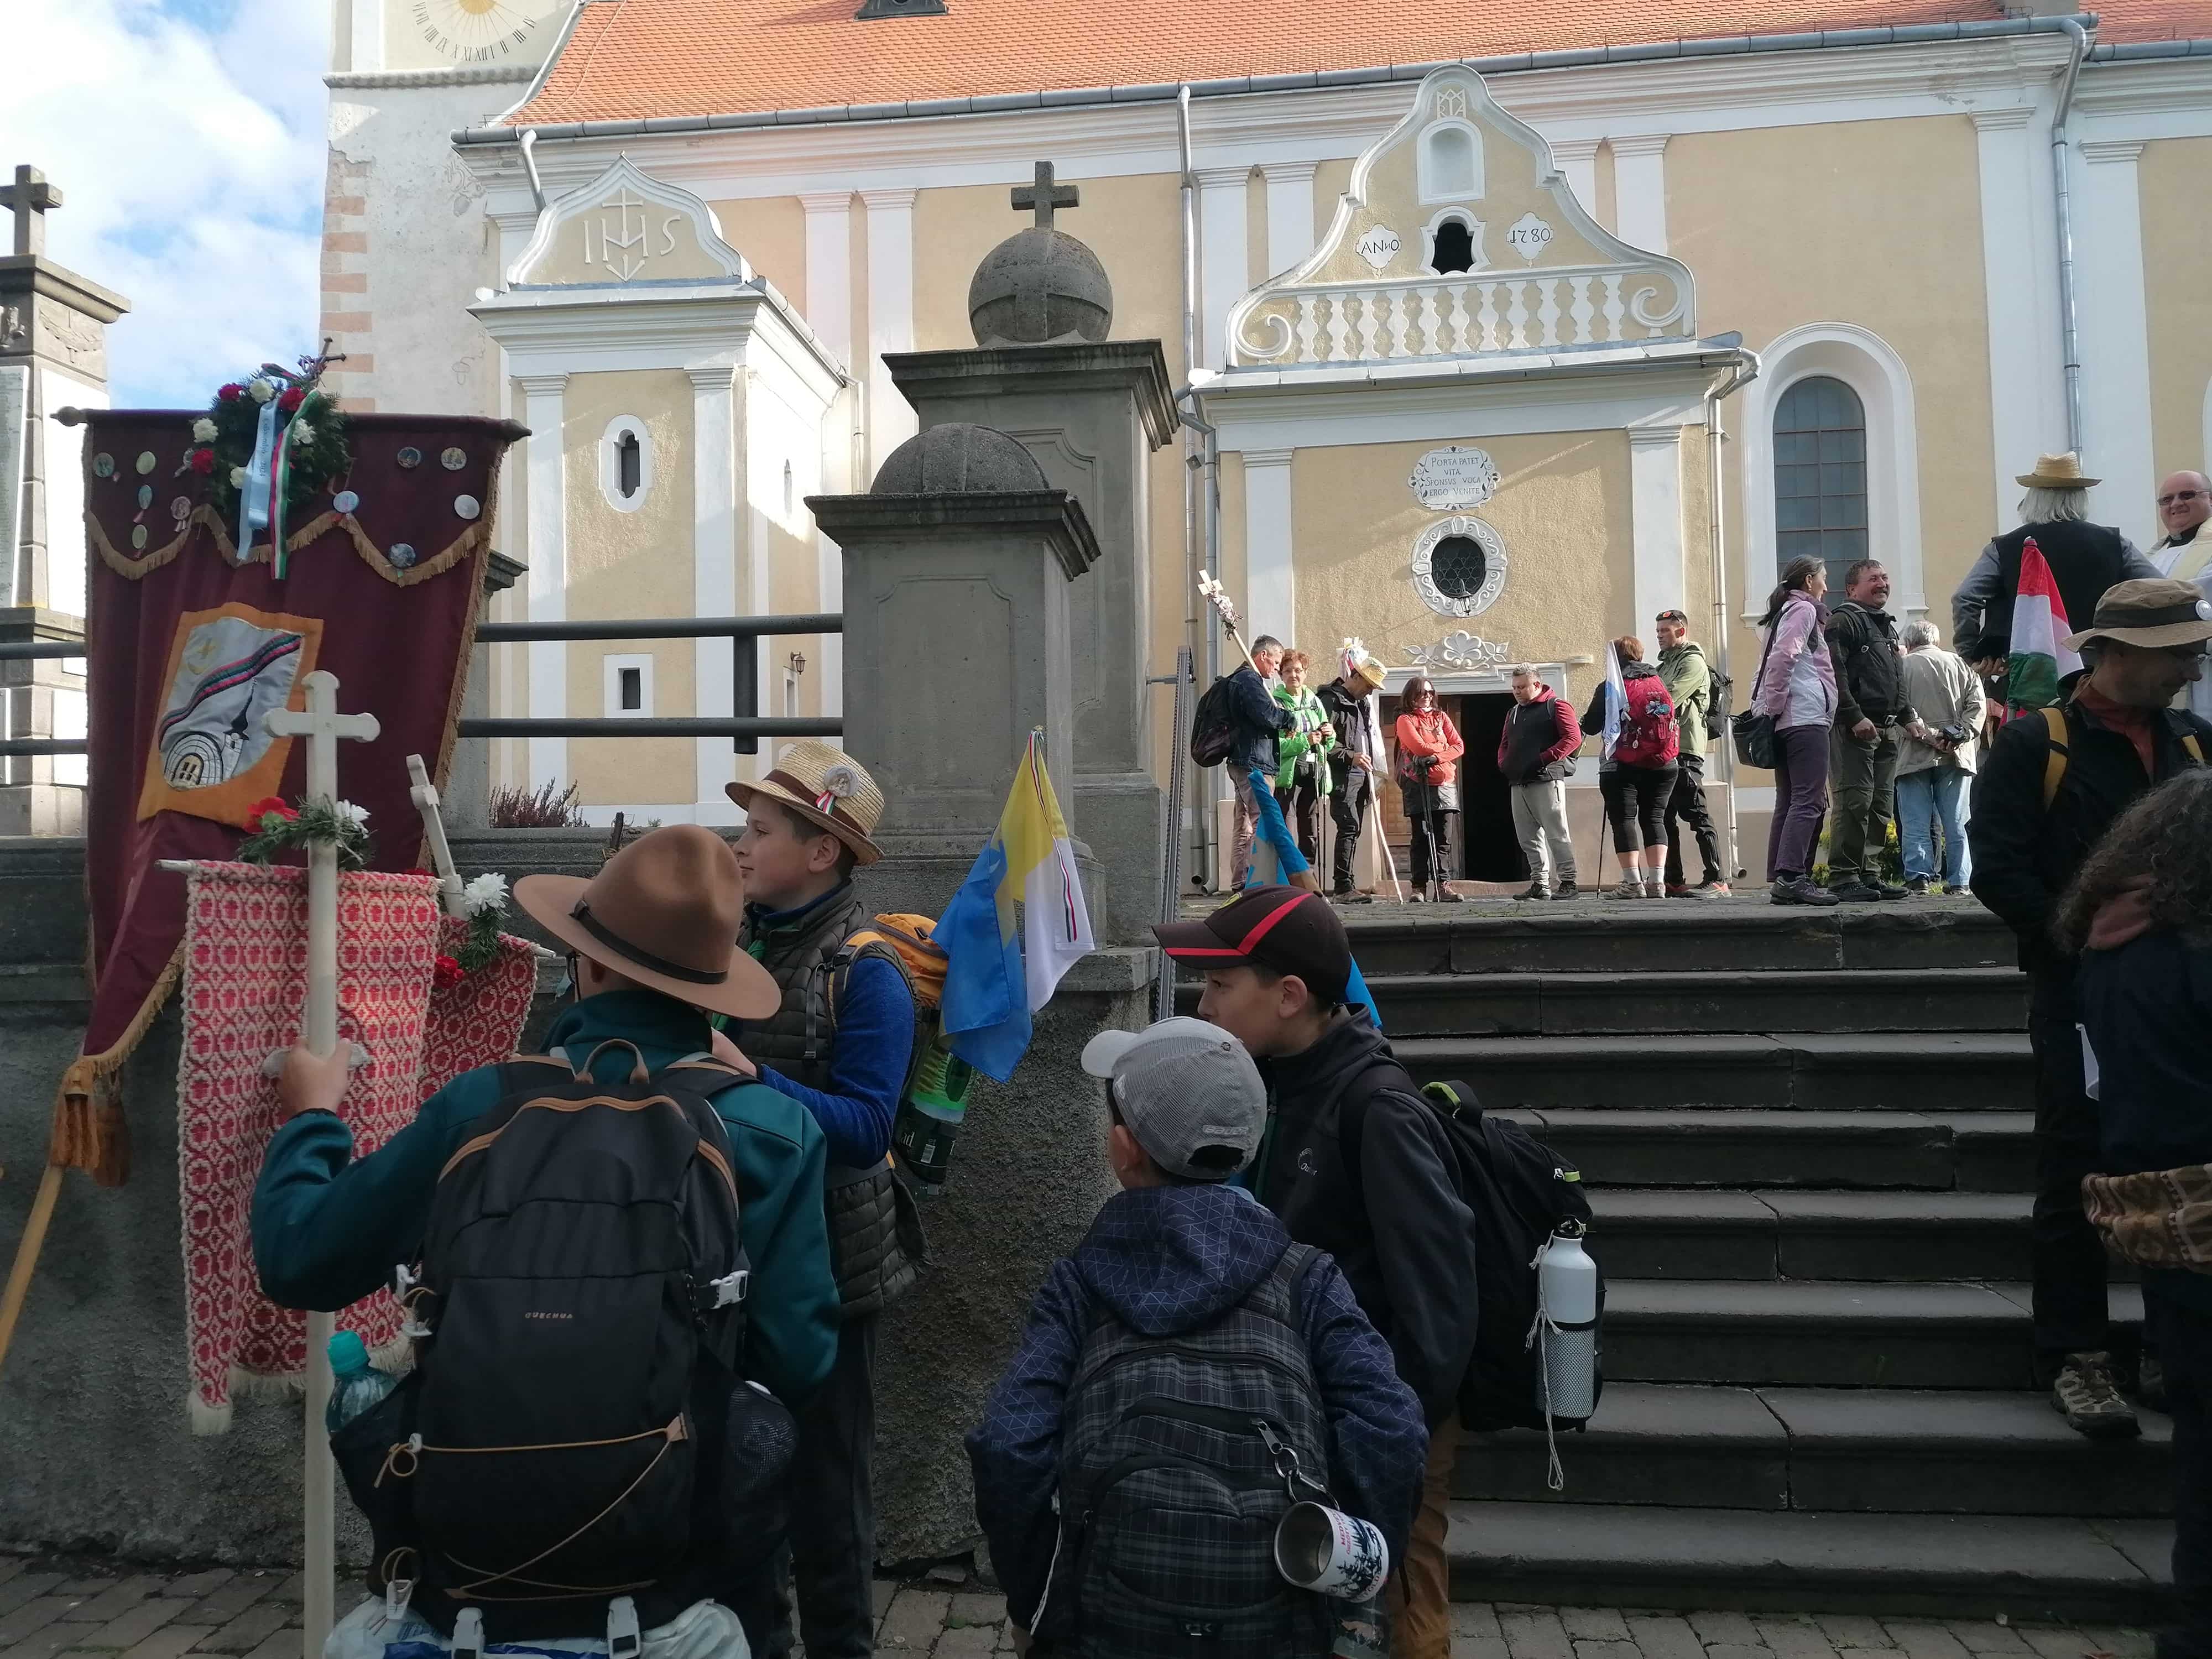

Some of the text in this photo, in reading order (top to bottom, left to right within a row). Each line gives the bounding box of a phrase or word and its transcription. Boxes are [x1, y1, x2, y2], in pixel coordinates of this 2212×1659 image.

[500, 40, 509, 54] II
[512, 29, 526, 44] III
[583, 214, 682, 264] IHS
[1510, 228, 1551, 243] 1780
[1431, 457, 1457, 467] PORTA
[1425, 477, 1456, 487] SPONSVS
